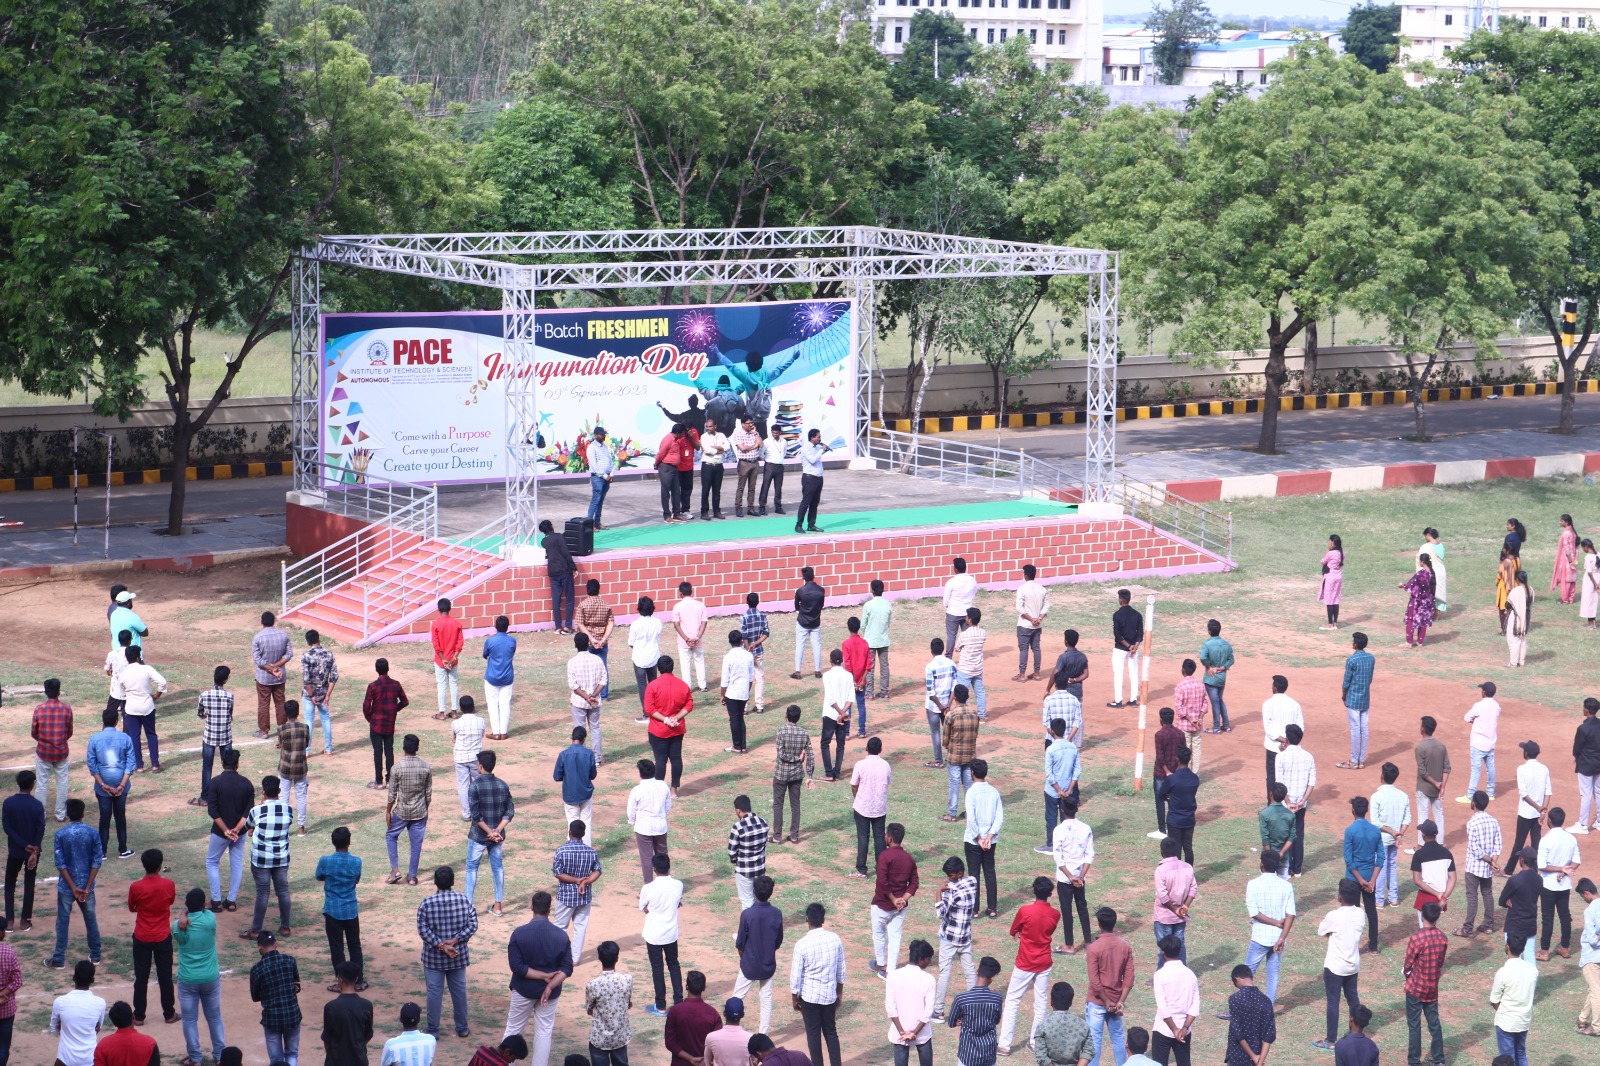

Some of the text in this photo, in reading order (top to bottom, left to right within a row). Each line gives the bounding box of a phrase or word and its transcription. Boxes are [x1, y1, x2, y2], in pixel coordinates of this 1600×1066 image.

[544, 322, 584, 339] Batch
[587, 318, 669, 340] FRESHMEN
[393, 338, 453, 365] PACE
[643, 345, 708, 379] Day
[570, 384, 613, 403] September
[421, 430, 440, 440] with
[448, 426, 492, 442] Purpose
[402, 443, 479, 456] Carve your Career
[383, 458, 422, 472] Create
[424, 461, 449, 473] your
